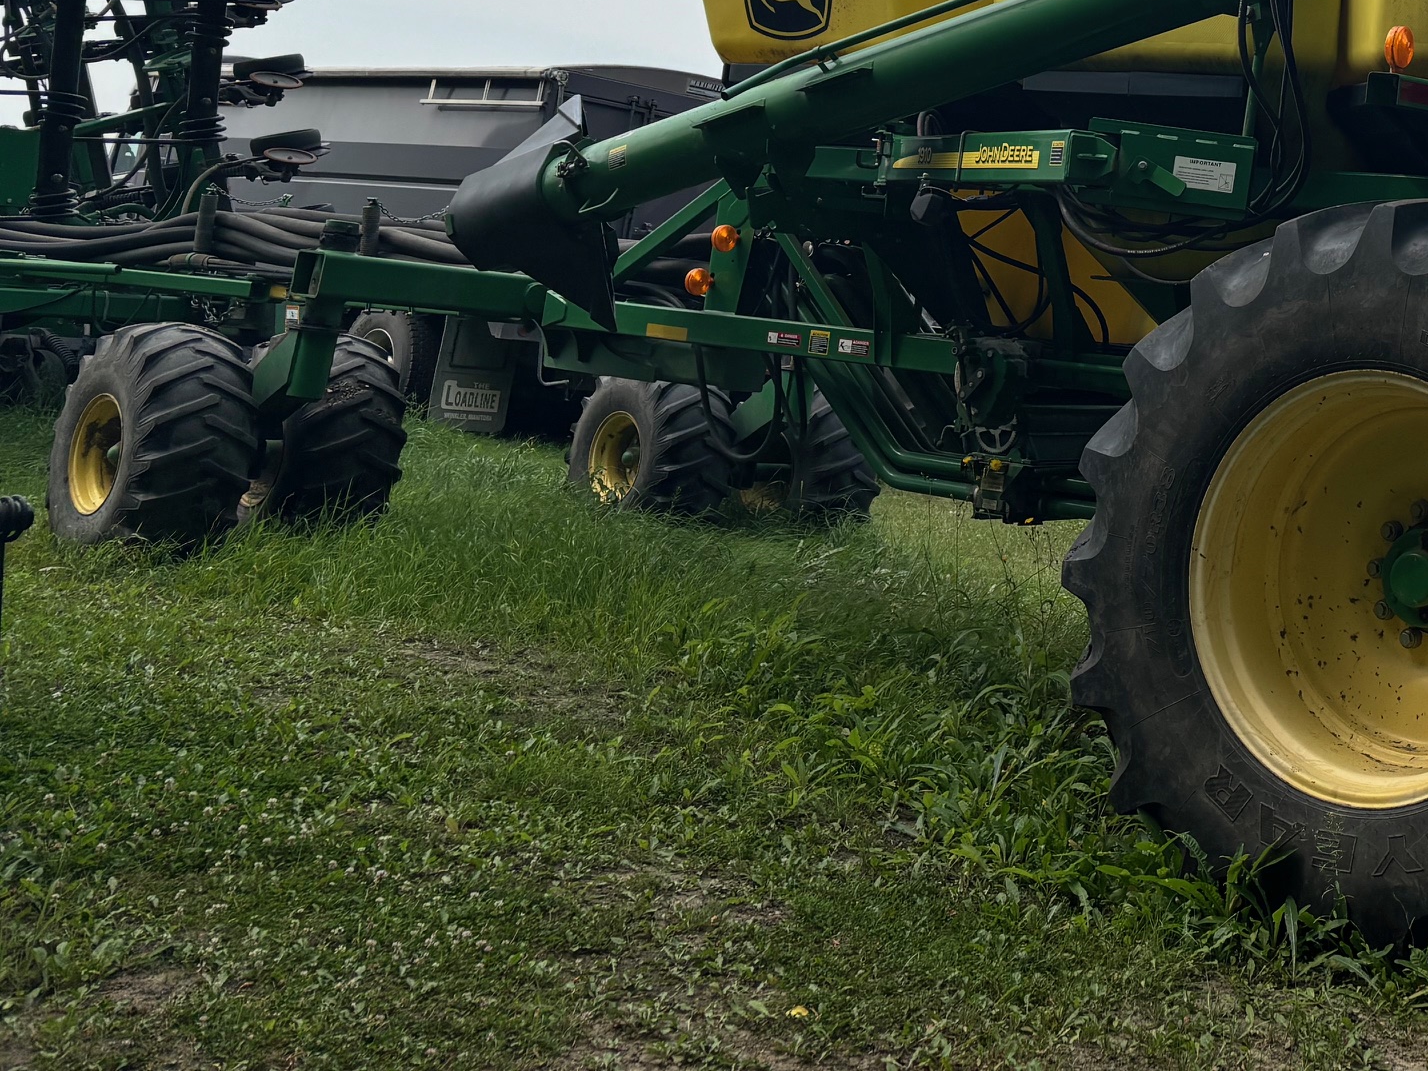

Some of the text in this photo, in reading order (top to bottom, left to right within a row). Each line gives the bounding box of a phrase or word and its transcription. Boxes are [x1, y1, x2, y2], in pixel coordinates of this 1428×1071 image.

[917, 147, 932, 164] 1910
[975, 143, 1000, 164] JOHN
[1000, 142, 1034, 164] DEERE
[1189, 159, 1222, 168] IMPORTANT
[445, 384, 497, 409] LOADLINE
